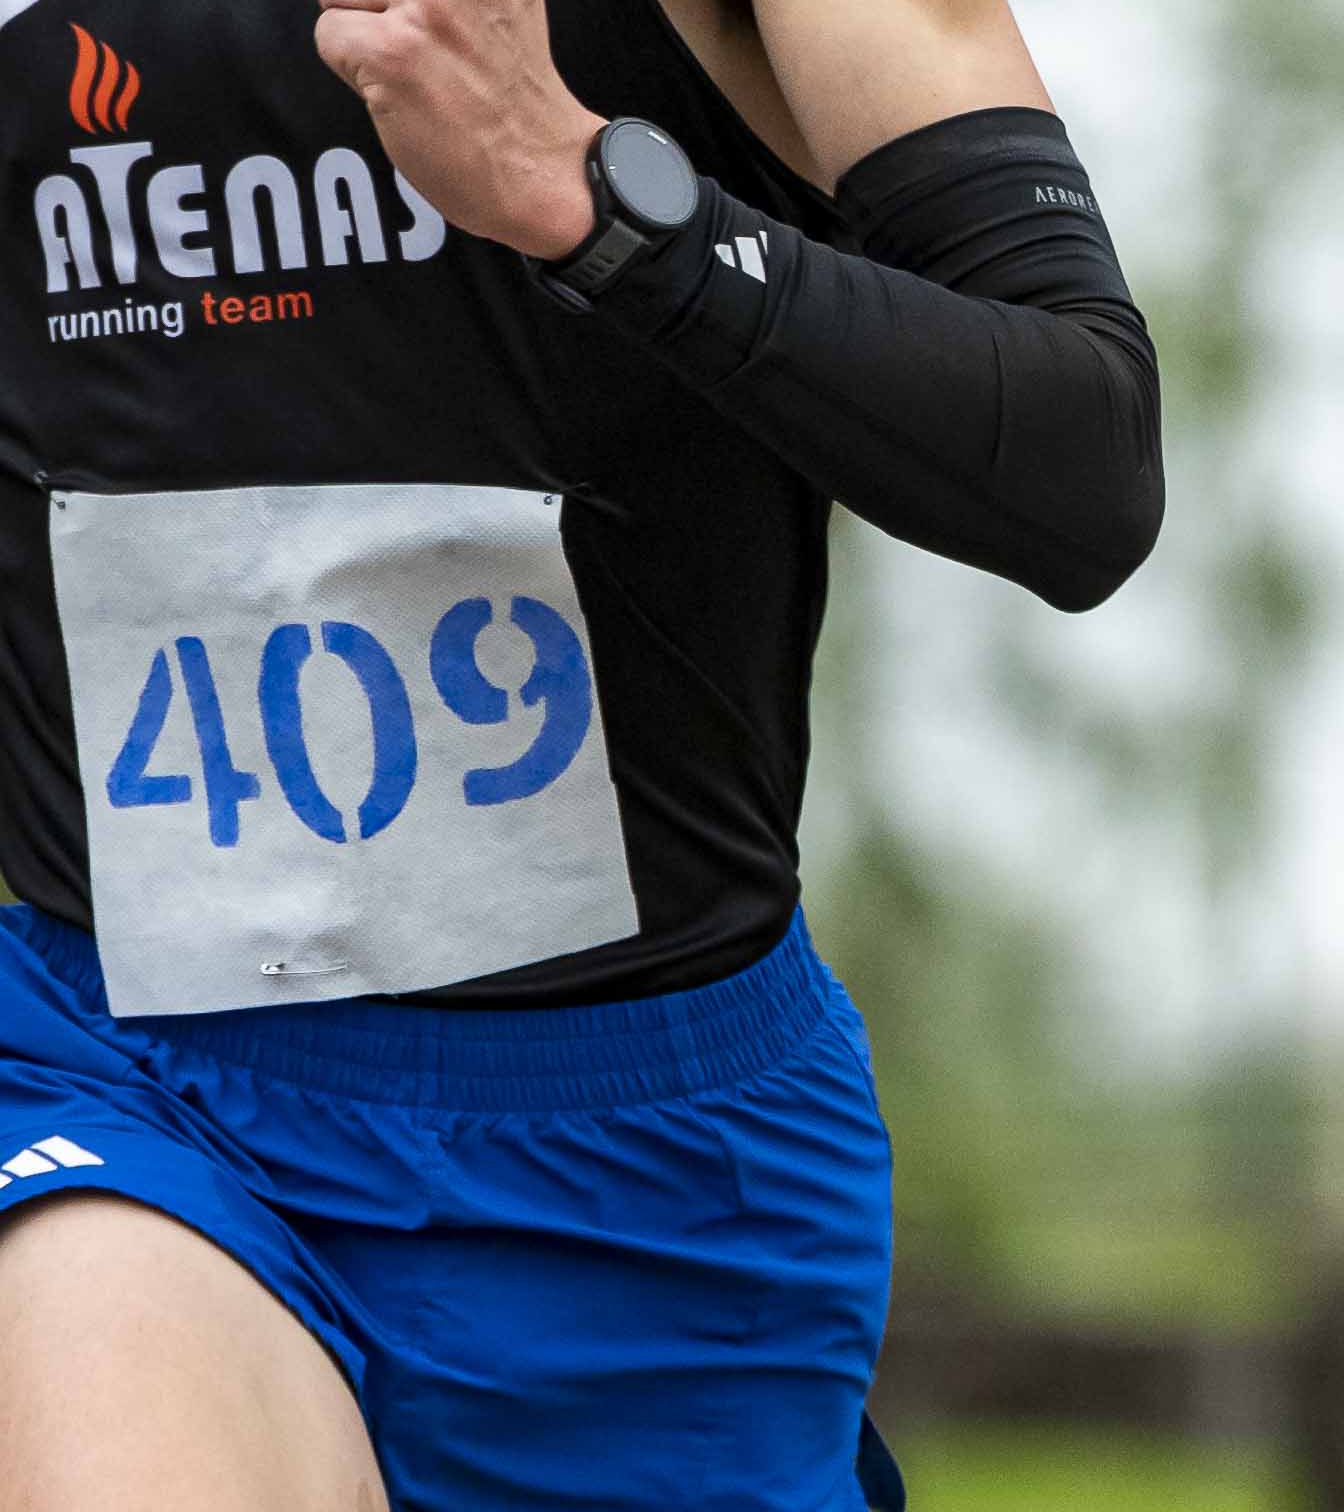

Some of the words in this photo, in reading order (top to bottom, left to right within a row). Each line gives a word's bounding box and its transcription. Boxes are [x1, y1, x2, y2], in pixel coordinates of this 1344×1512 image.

[1035, 186, 1098, 214] AERORE
[47, 297, 184, 343] running
[201, 291, 314, 325] team
[106, 596, 593, 848] 409
